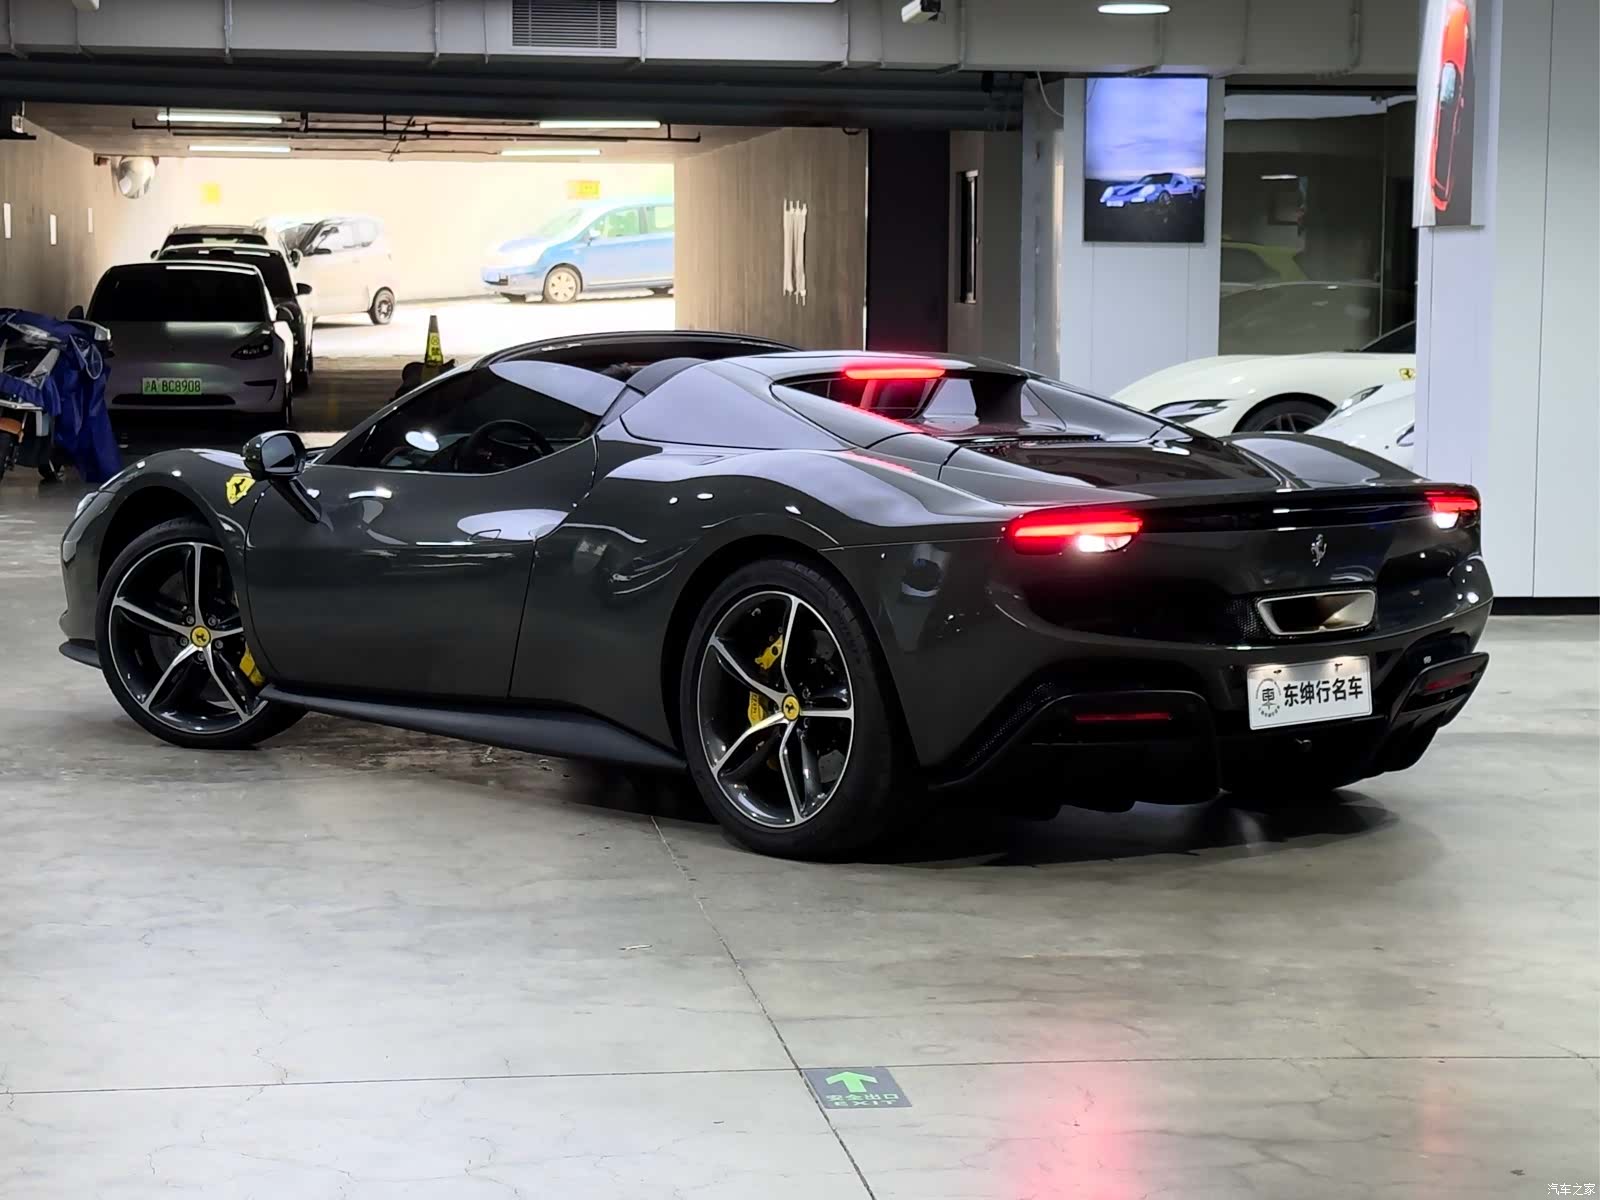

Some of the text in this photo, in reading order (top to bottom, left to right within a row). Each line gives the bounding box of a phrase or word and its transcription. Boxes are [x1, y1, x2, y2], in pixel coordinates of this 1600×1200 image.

[1283, 676, 1363, 707] 东绅行名车
